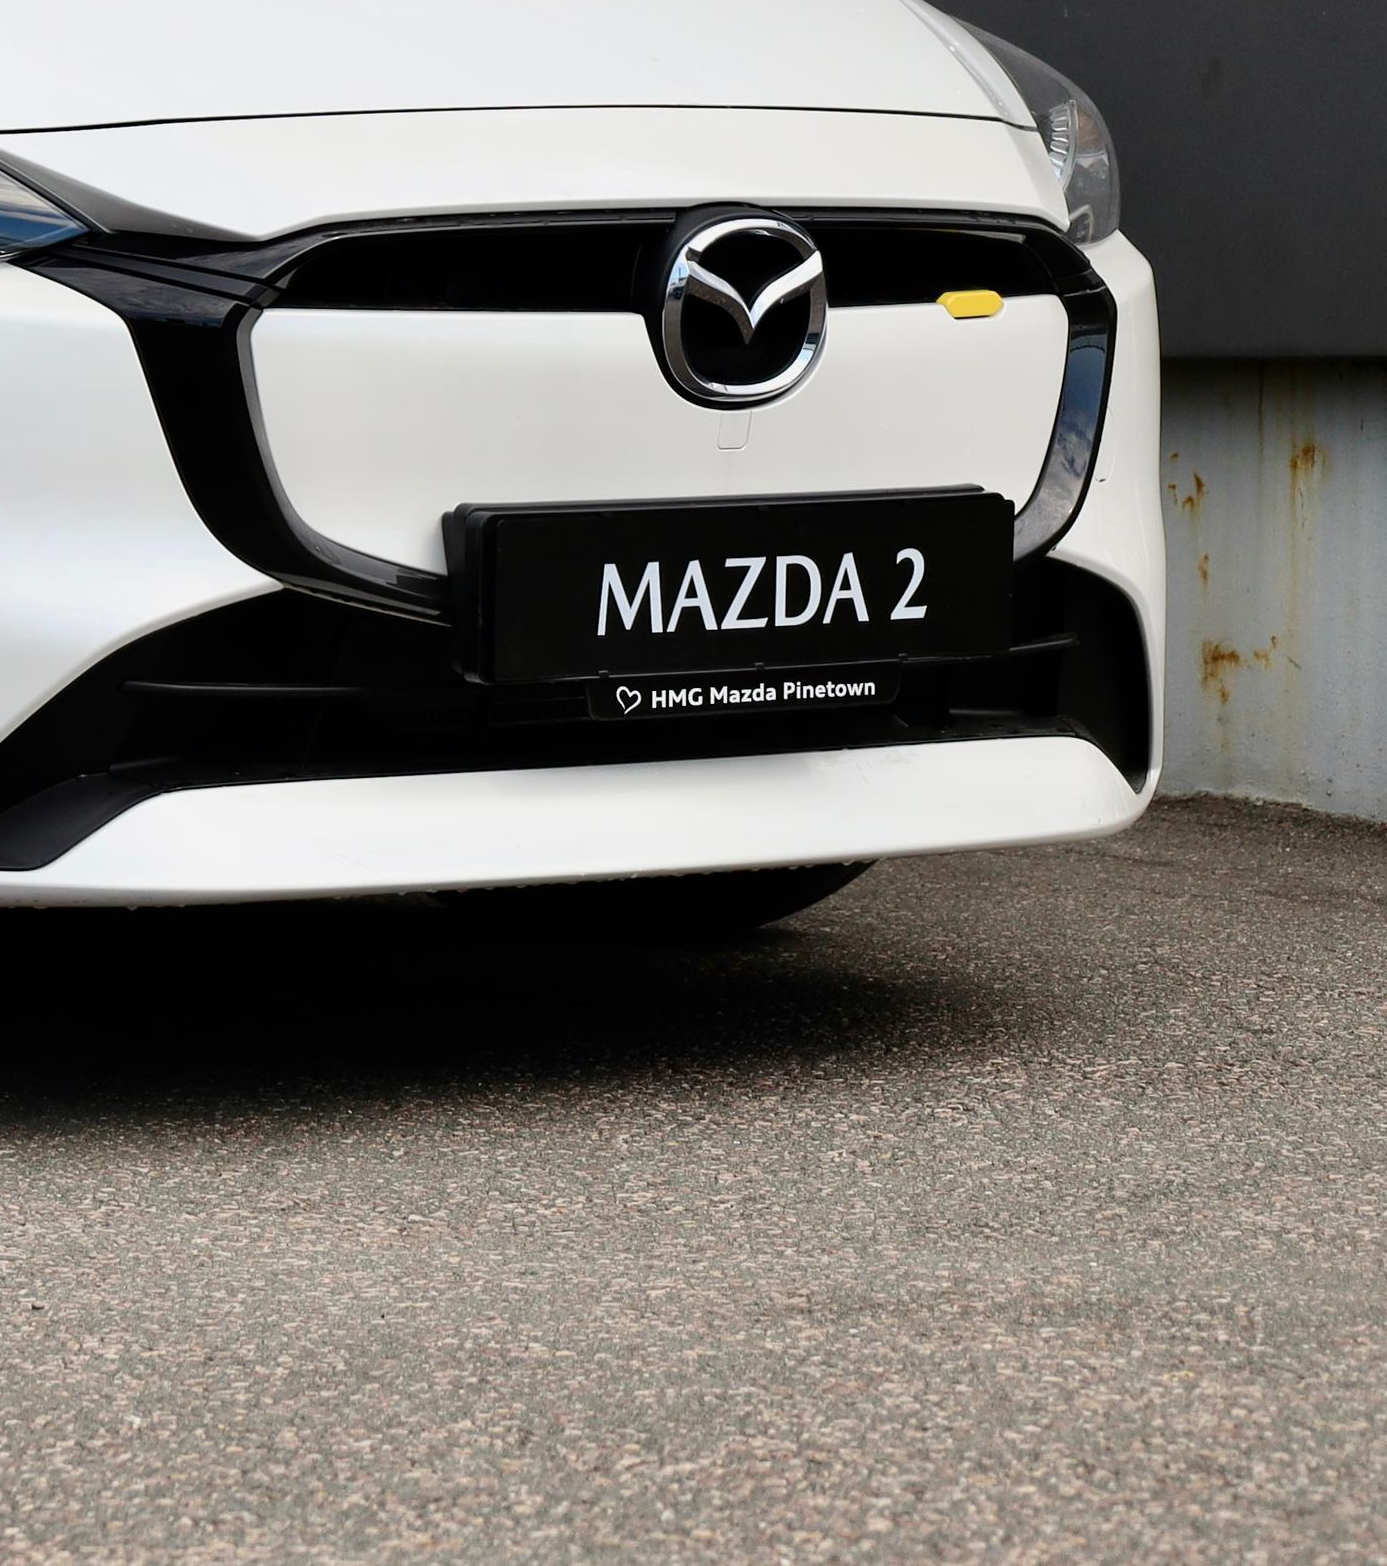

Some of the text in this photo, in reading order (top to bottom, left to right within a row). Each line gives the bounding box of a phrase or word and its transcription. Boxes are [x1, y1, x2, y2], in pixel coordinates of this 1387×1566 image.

[596, 547, 928, 636] MAZDA 2
[651, 680, 876, 709] HMG Mazda Pinetown
